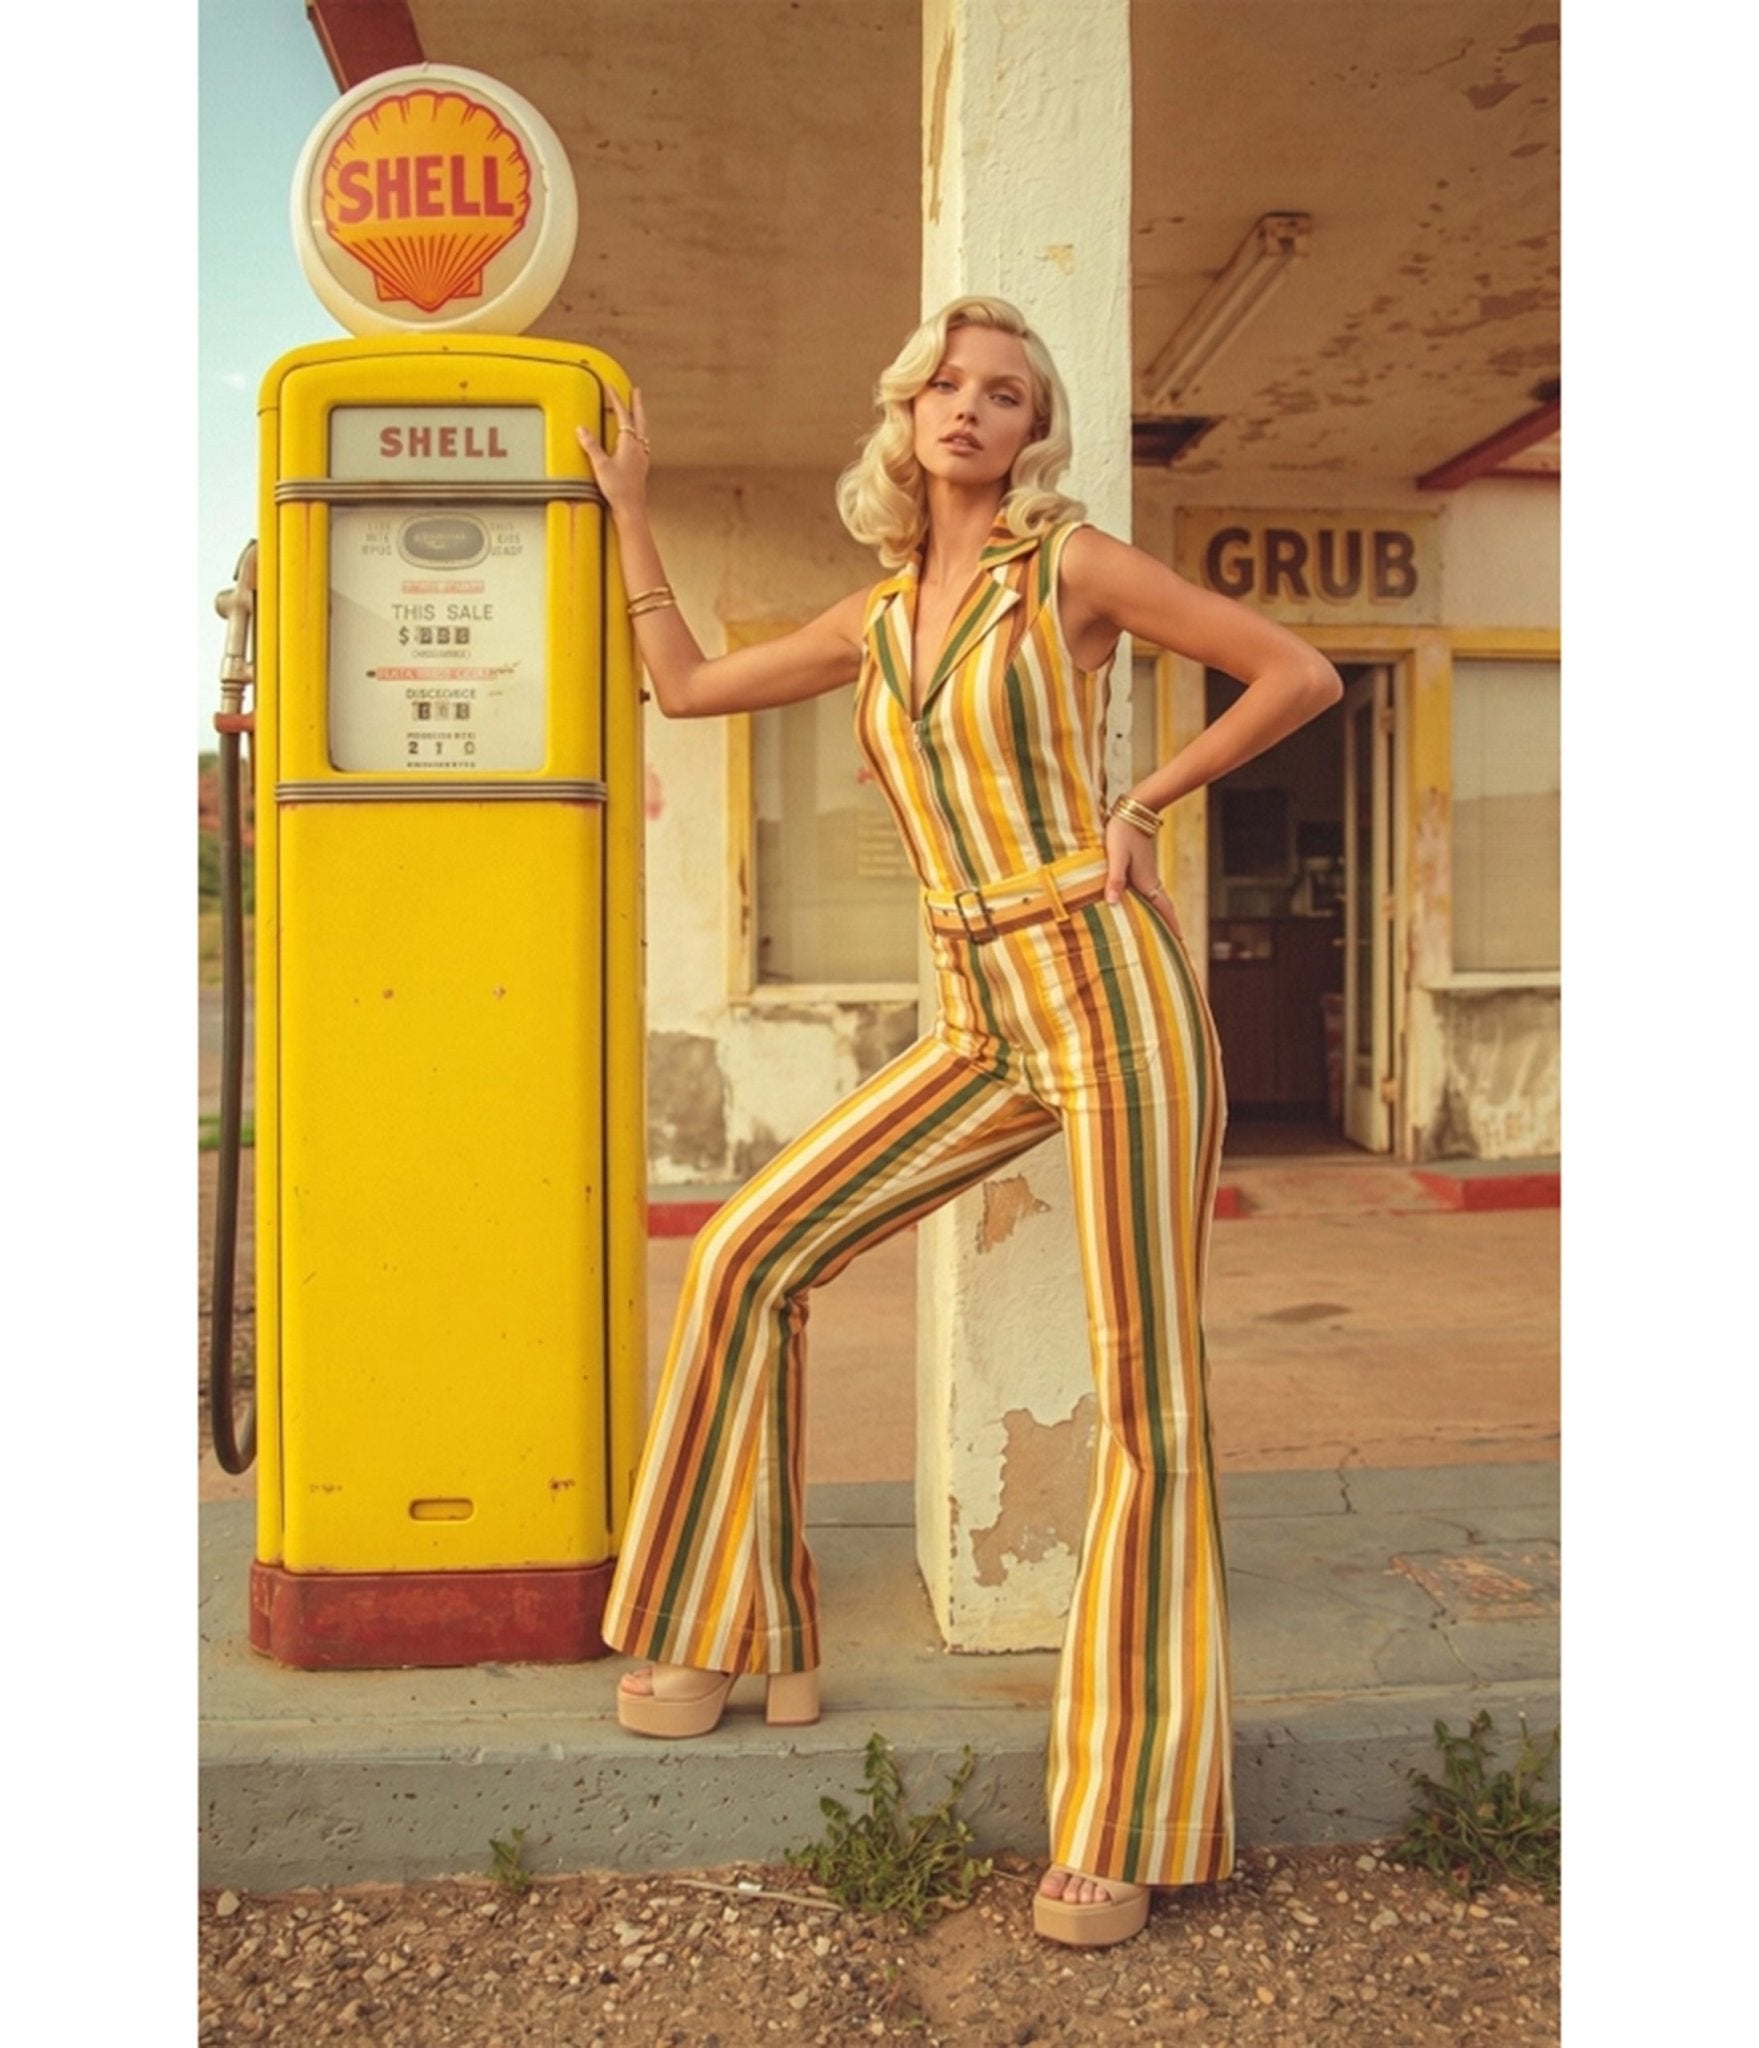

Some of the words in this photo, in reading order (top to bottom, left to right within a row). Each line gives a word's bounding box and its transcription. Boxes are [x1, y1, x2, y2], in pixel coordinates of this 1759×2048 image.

[337, 154, 515, 225] SHELL
[379, 426, 508, 459] SHELL
[1204, 526, 1418, 601] GRUB
[392, 604, 436, 621] THIS
[447, 604, 494, 621] SALE
